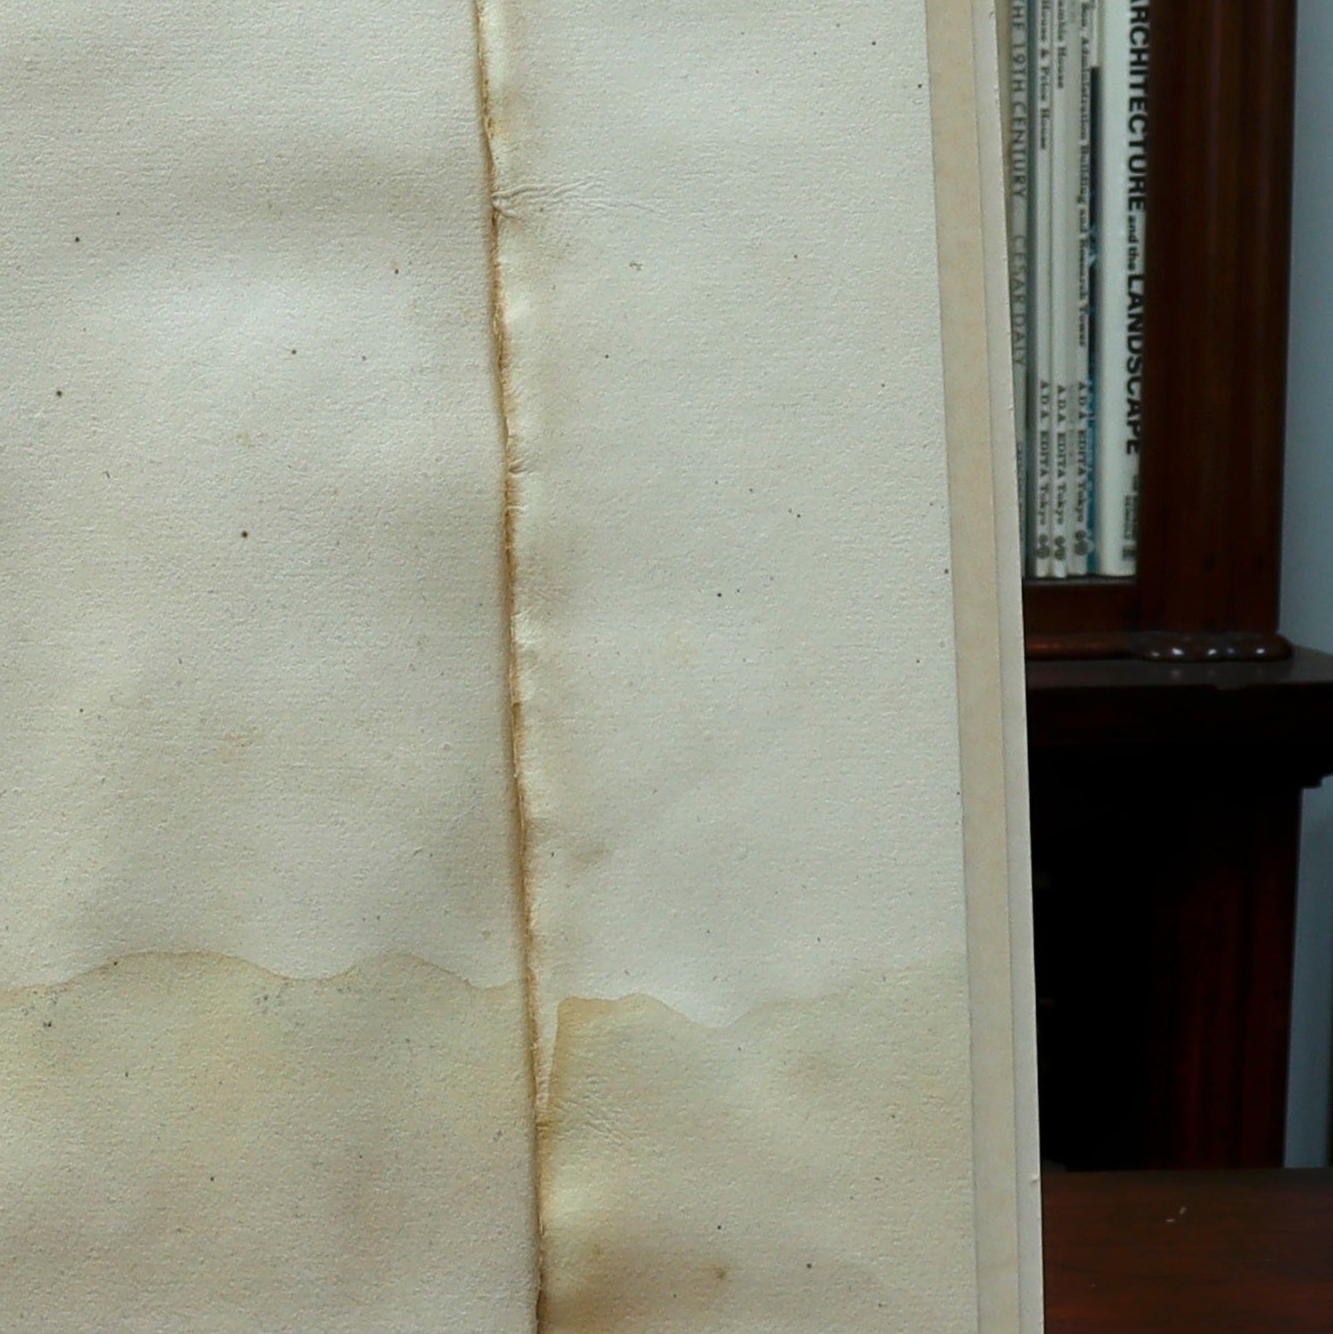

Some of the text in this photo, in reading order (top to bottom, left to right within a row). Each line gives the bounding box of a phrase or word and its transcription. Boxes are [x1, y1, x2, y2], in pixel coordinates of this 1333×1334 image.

[1012, 41, 1027, 94] 19TH
[1012, 100, 1026, 199] CENTURY
[1127, 215, 1141, 243] and
[1127, 246, 1140, 271] the
[1125, 274, 1146, 455] LANDSCAPE
[1039, 428, 1051, 478] EDITA
[1056, 431, 1068, 479] EDITA
[1077, 428, 1088, 477] EDITA
